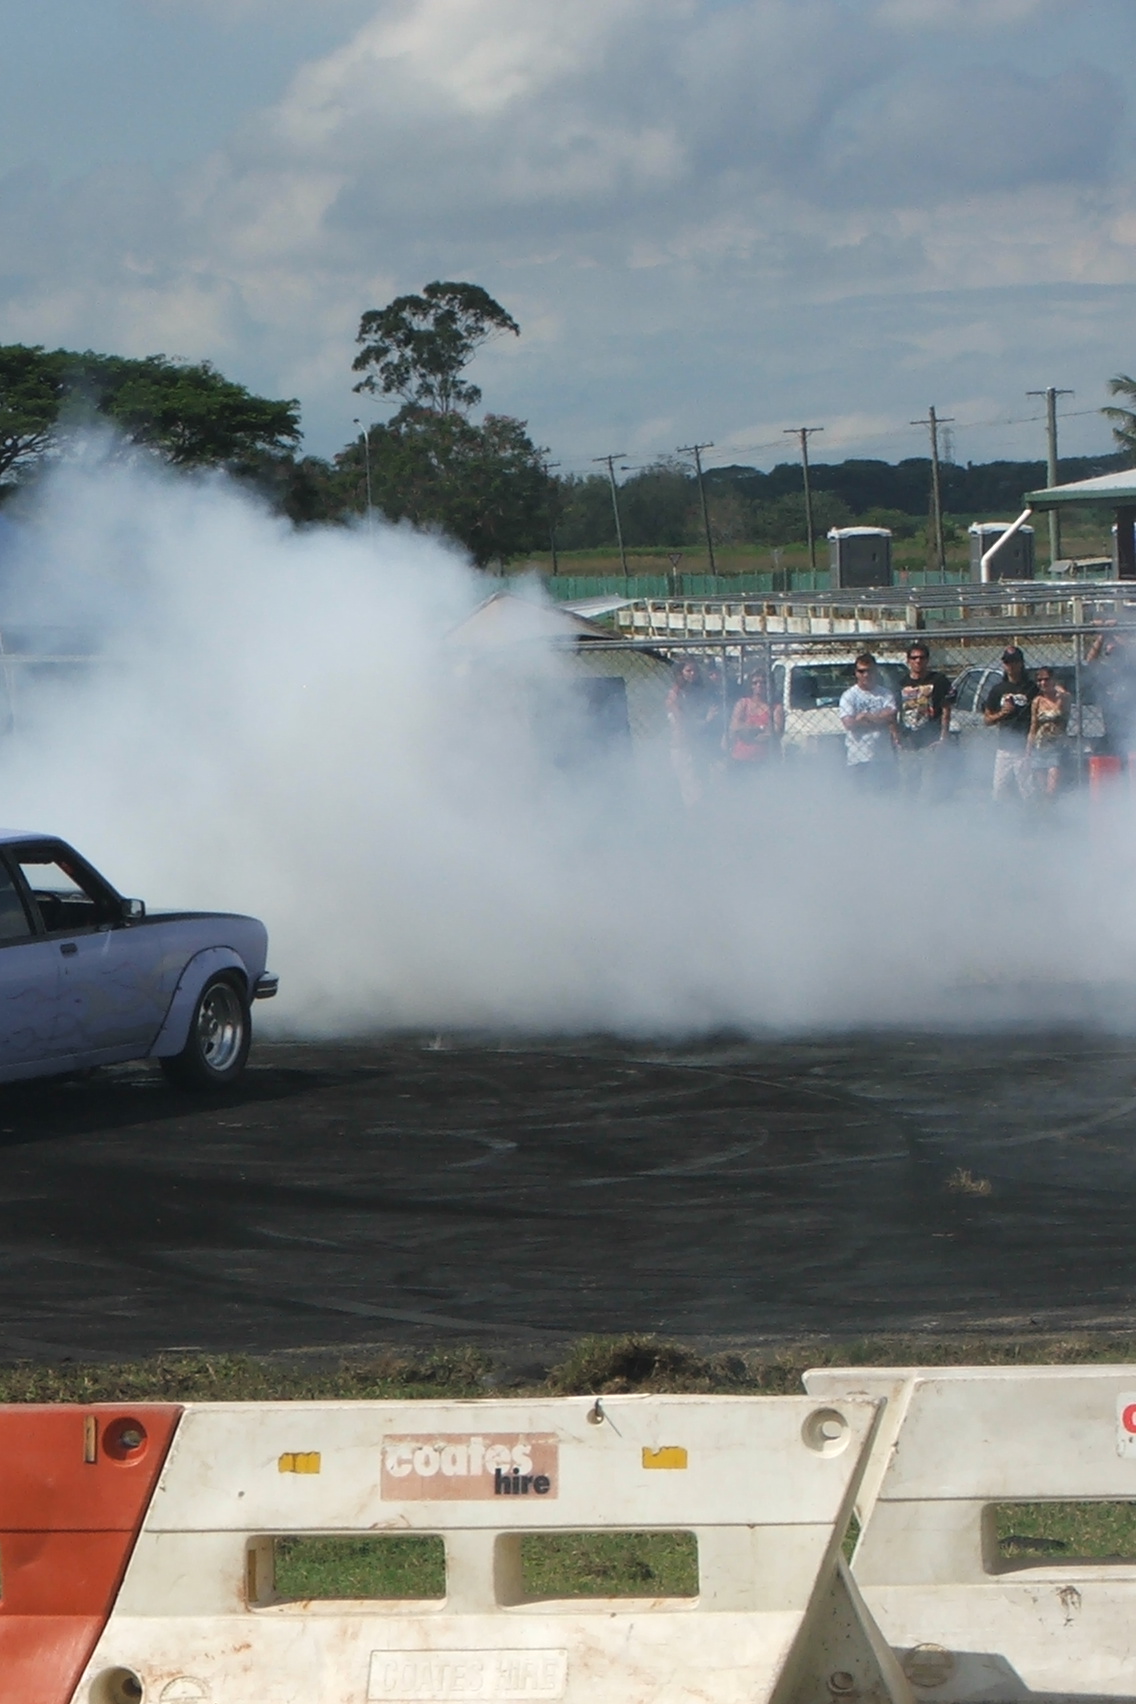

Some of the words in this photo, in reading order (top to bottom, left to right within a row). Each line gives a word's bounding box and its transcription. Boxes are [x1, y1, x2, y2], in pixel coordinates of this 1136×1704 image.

[383, 1437, 534, 1477] coates
[493, 1468, 551, 1495] hire
[383, 1659, 484, 1692] COATES
